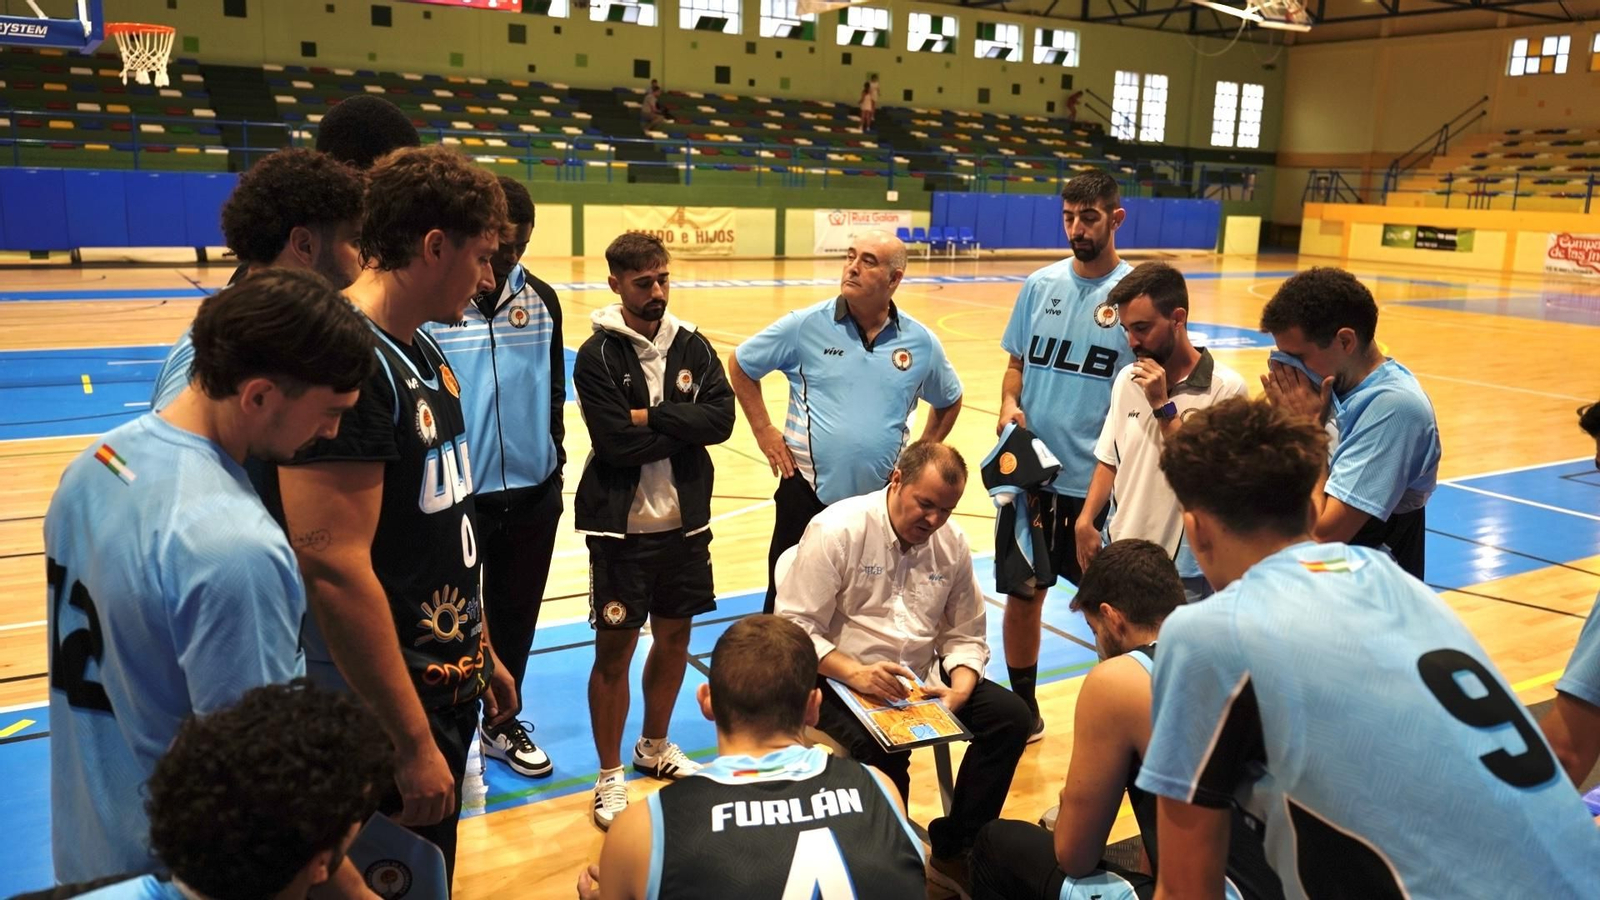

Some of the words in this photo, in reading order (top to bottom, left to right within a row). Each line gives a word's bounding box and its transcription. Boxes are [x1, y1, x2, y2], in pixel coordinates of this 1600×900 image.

[695, 229, 735, 244] HIJOS
[1045, 308, 1062, 316] vive
[823, 347, 844, 356] vive
[1028, 334, 1120, 378] ULB
[1417, 648, 1558, 790] 9
[711, 787, 864, 833] FURLÁN
